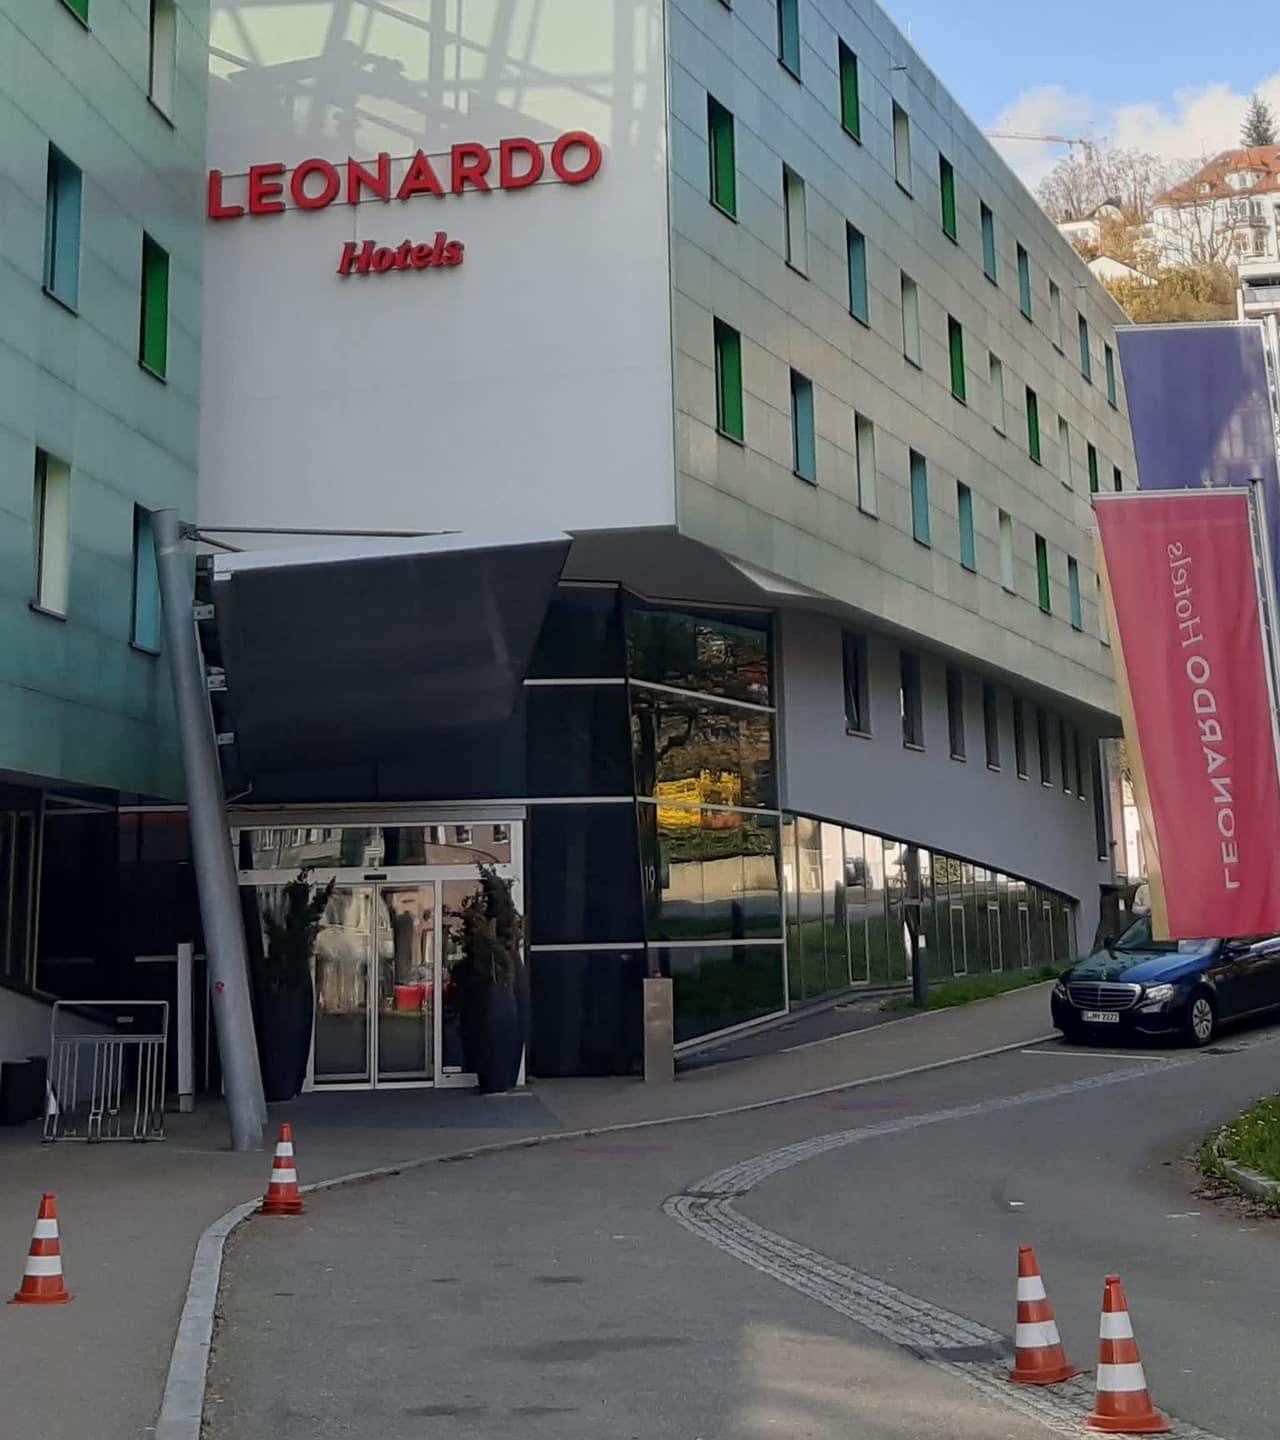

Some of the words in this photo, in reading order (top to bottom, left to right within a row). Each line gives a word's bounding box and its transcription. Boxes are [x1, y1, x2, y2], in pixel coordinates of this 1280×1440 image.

[208, 130, 602, 219] LEONARDO
[337, 231, 464, 276] Hotels
[644, 865, 656, 893] 19
